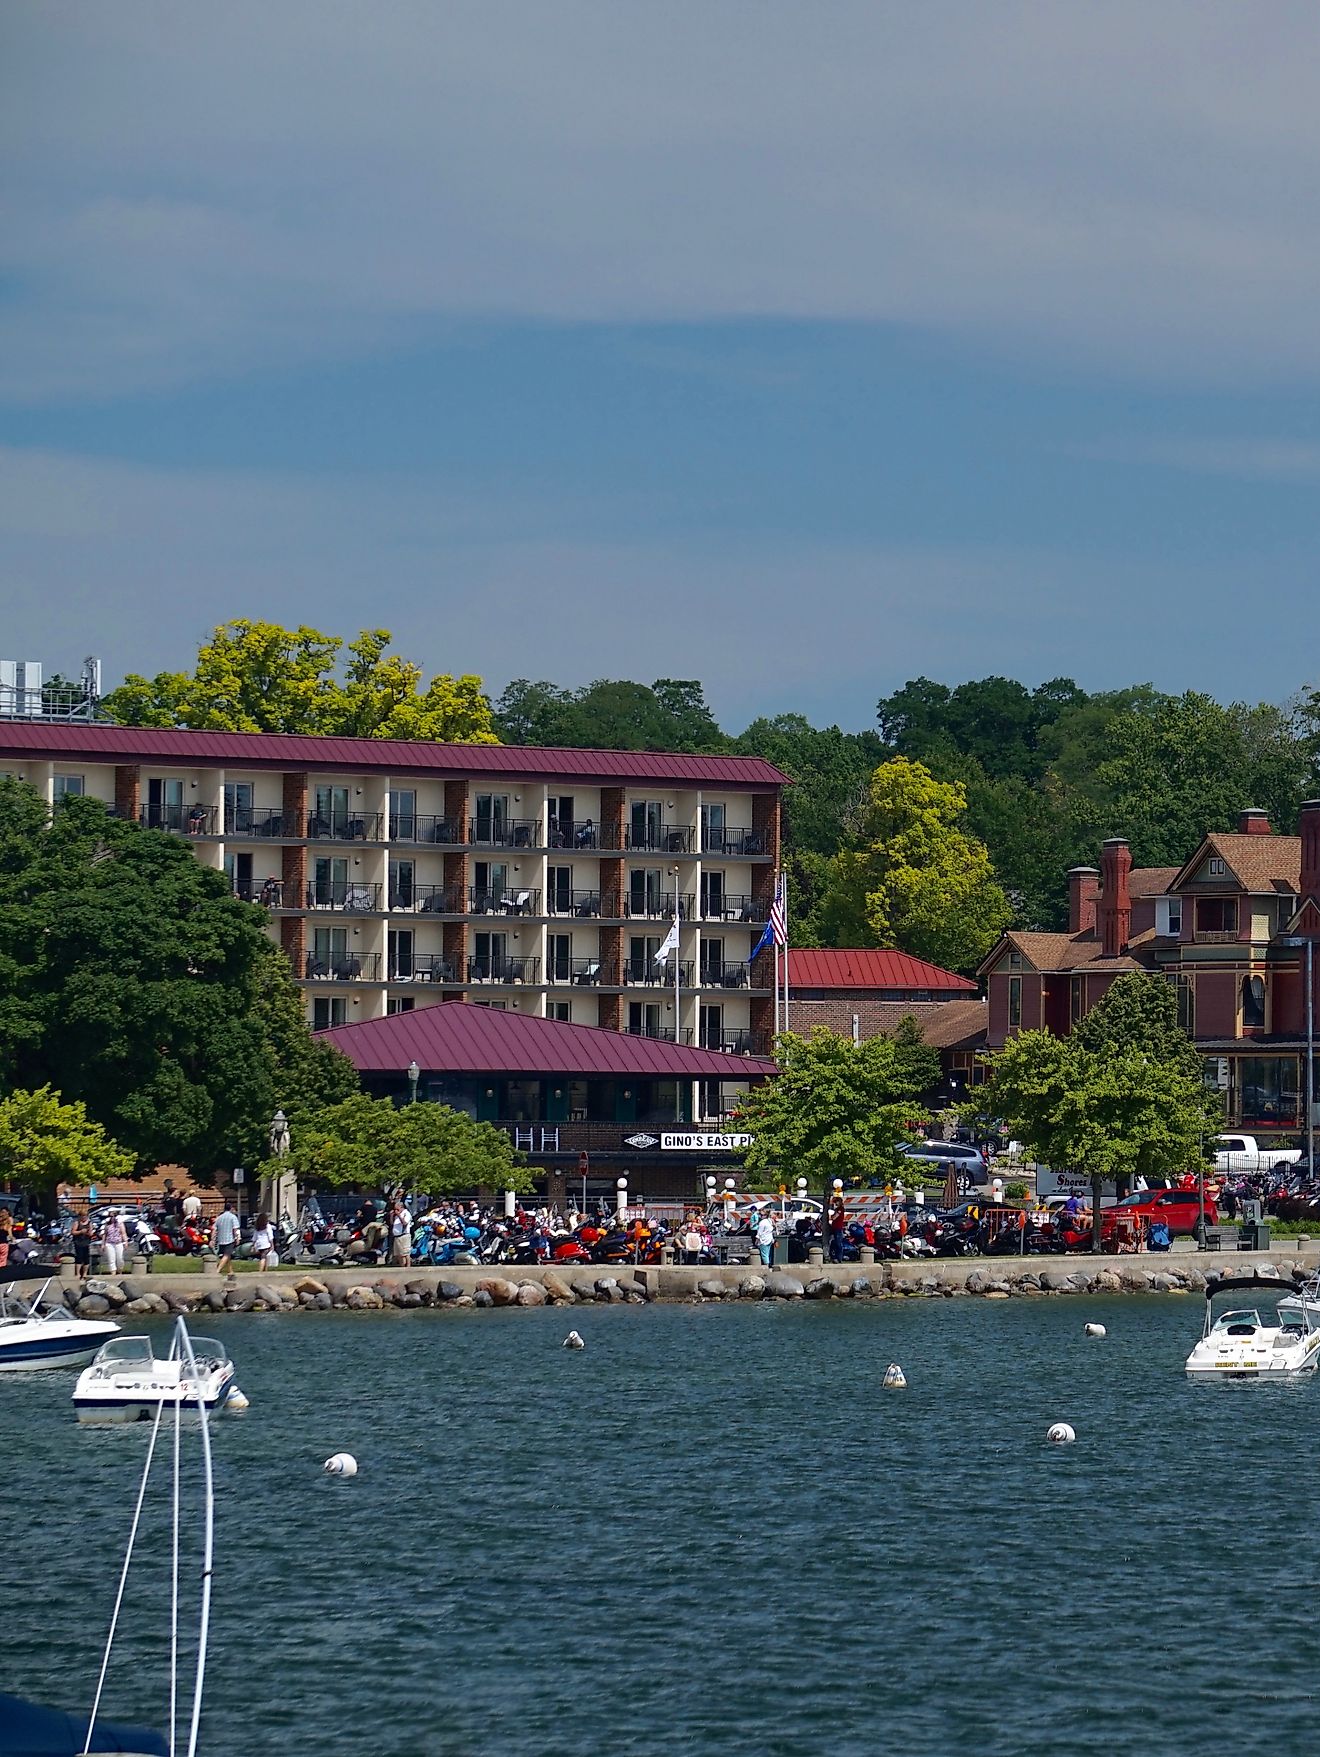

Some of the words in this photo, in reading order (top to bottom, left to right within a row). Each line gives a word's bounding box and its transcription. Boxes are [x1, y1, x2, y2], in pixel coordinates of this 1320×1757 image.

[664, 1135, 703, 1147] GINO'S
[707, 1136, 736, 1146] EAST
[1057, 1174, 1087, 1186] Shores
[181, 1383, 188, 1391] 12
